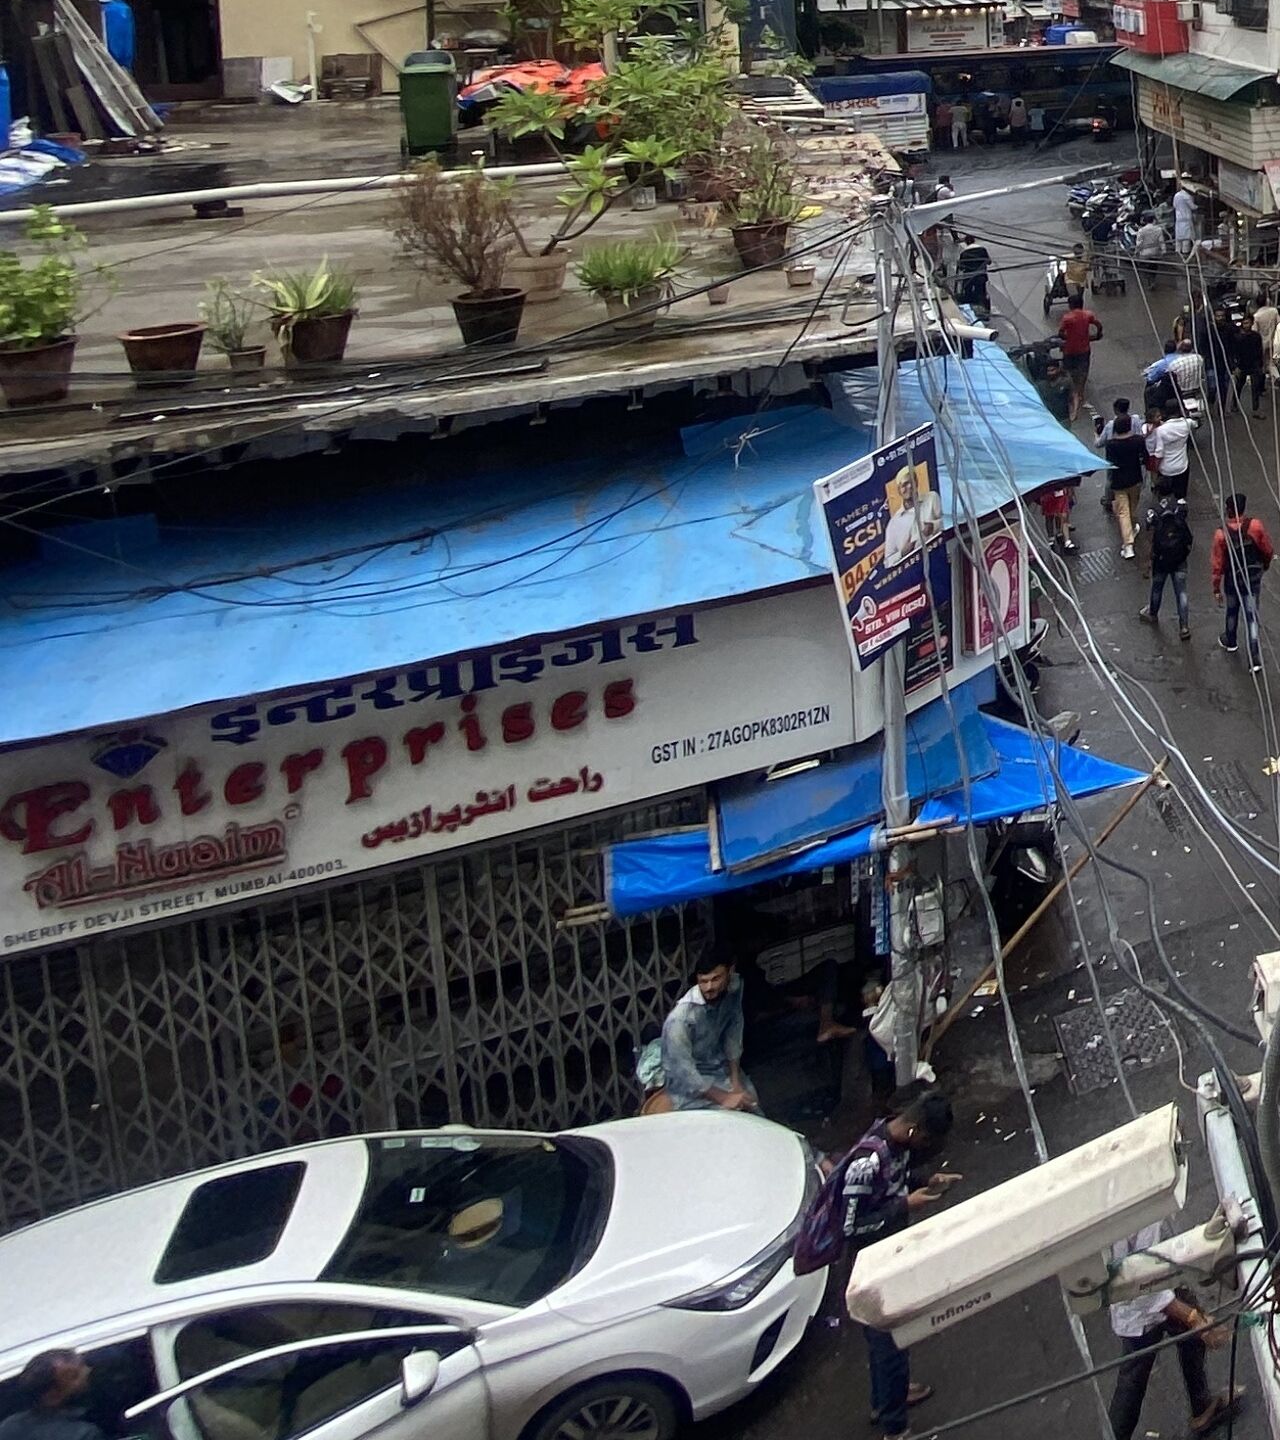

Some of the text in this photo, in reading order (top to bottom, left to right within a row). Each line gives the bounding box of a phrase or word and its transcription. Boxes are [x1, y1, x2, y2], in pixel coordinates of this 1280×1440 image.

[843, 519, 882, 555] SCSI
[0, 677, 638, 854] Enterprises
[651, 741, 680, 764] GST
[682, 736, 697, 758] IN
[3, 918, 78, 949] SHERIFF
[84, 906, 136, 930] DEVJI
[930, 1291, 992, 1328] Infinova
